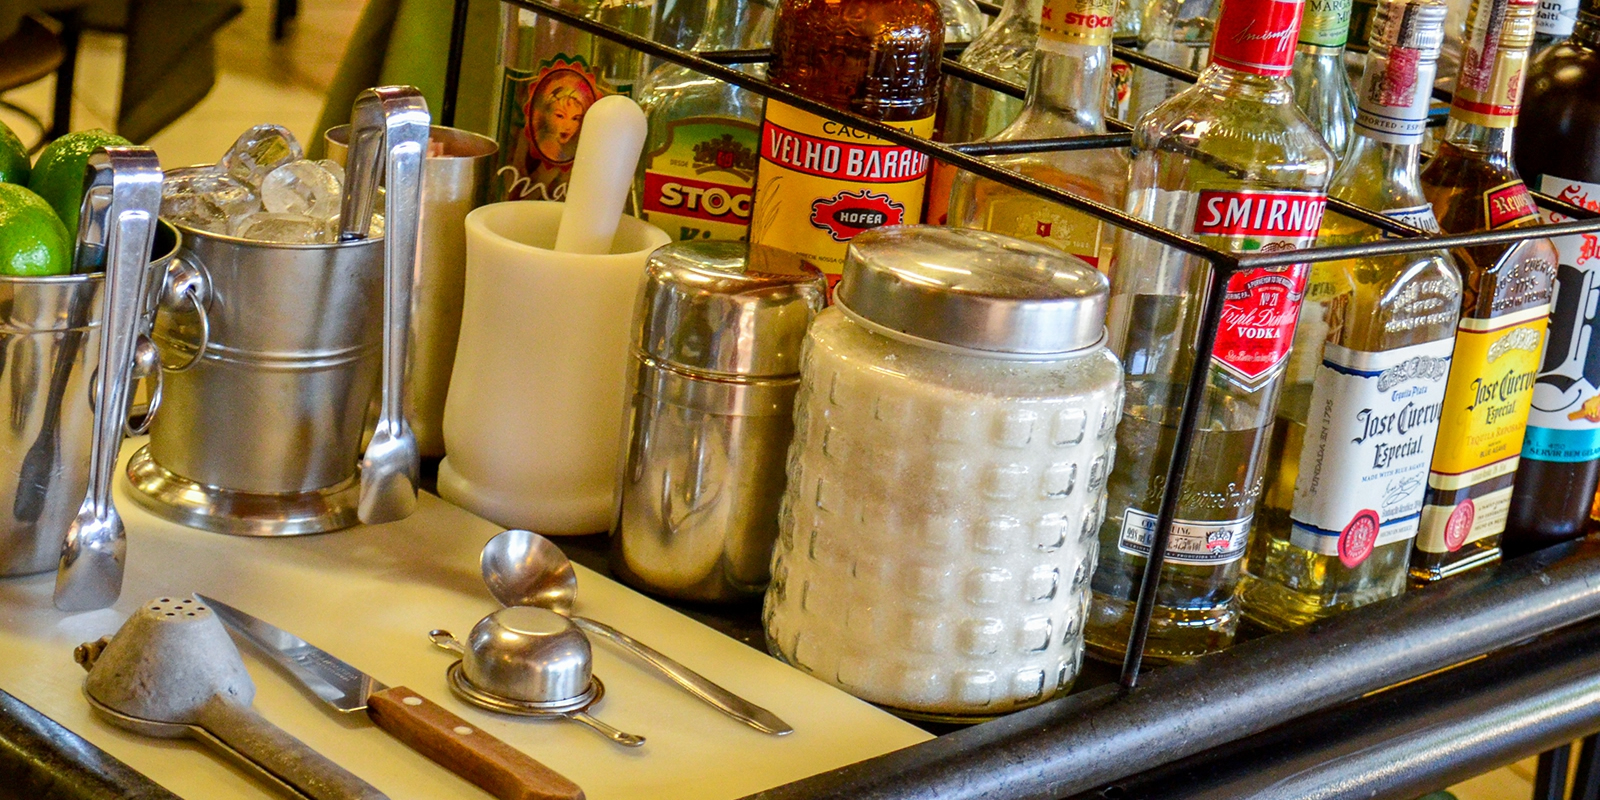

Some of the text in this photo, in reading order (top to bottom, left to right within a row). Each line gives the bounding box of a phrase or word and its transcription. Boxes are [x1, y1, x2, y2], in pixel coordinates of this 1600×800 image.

[1064, 12, 1114, 29] STOCK
[1538, 1, 1562, 11] un
[770, 128, 842, 174] VELHO
[659, 182, 751, 218] STOC
[840, 211, 883, 225] HOFER
[1220, 303, 1258, 332] Triple
[1237, 326, 1281, 340] VODKA
[1464, 377, 1499, 413] Jose
[1350, 408, 1396, 446] Jose
[1309, 399, 1334, 496] FUNDADA EN 1795
